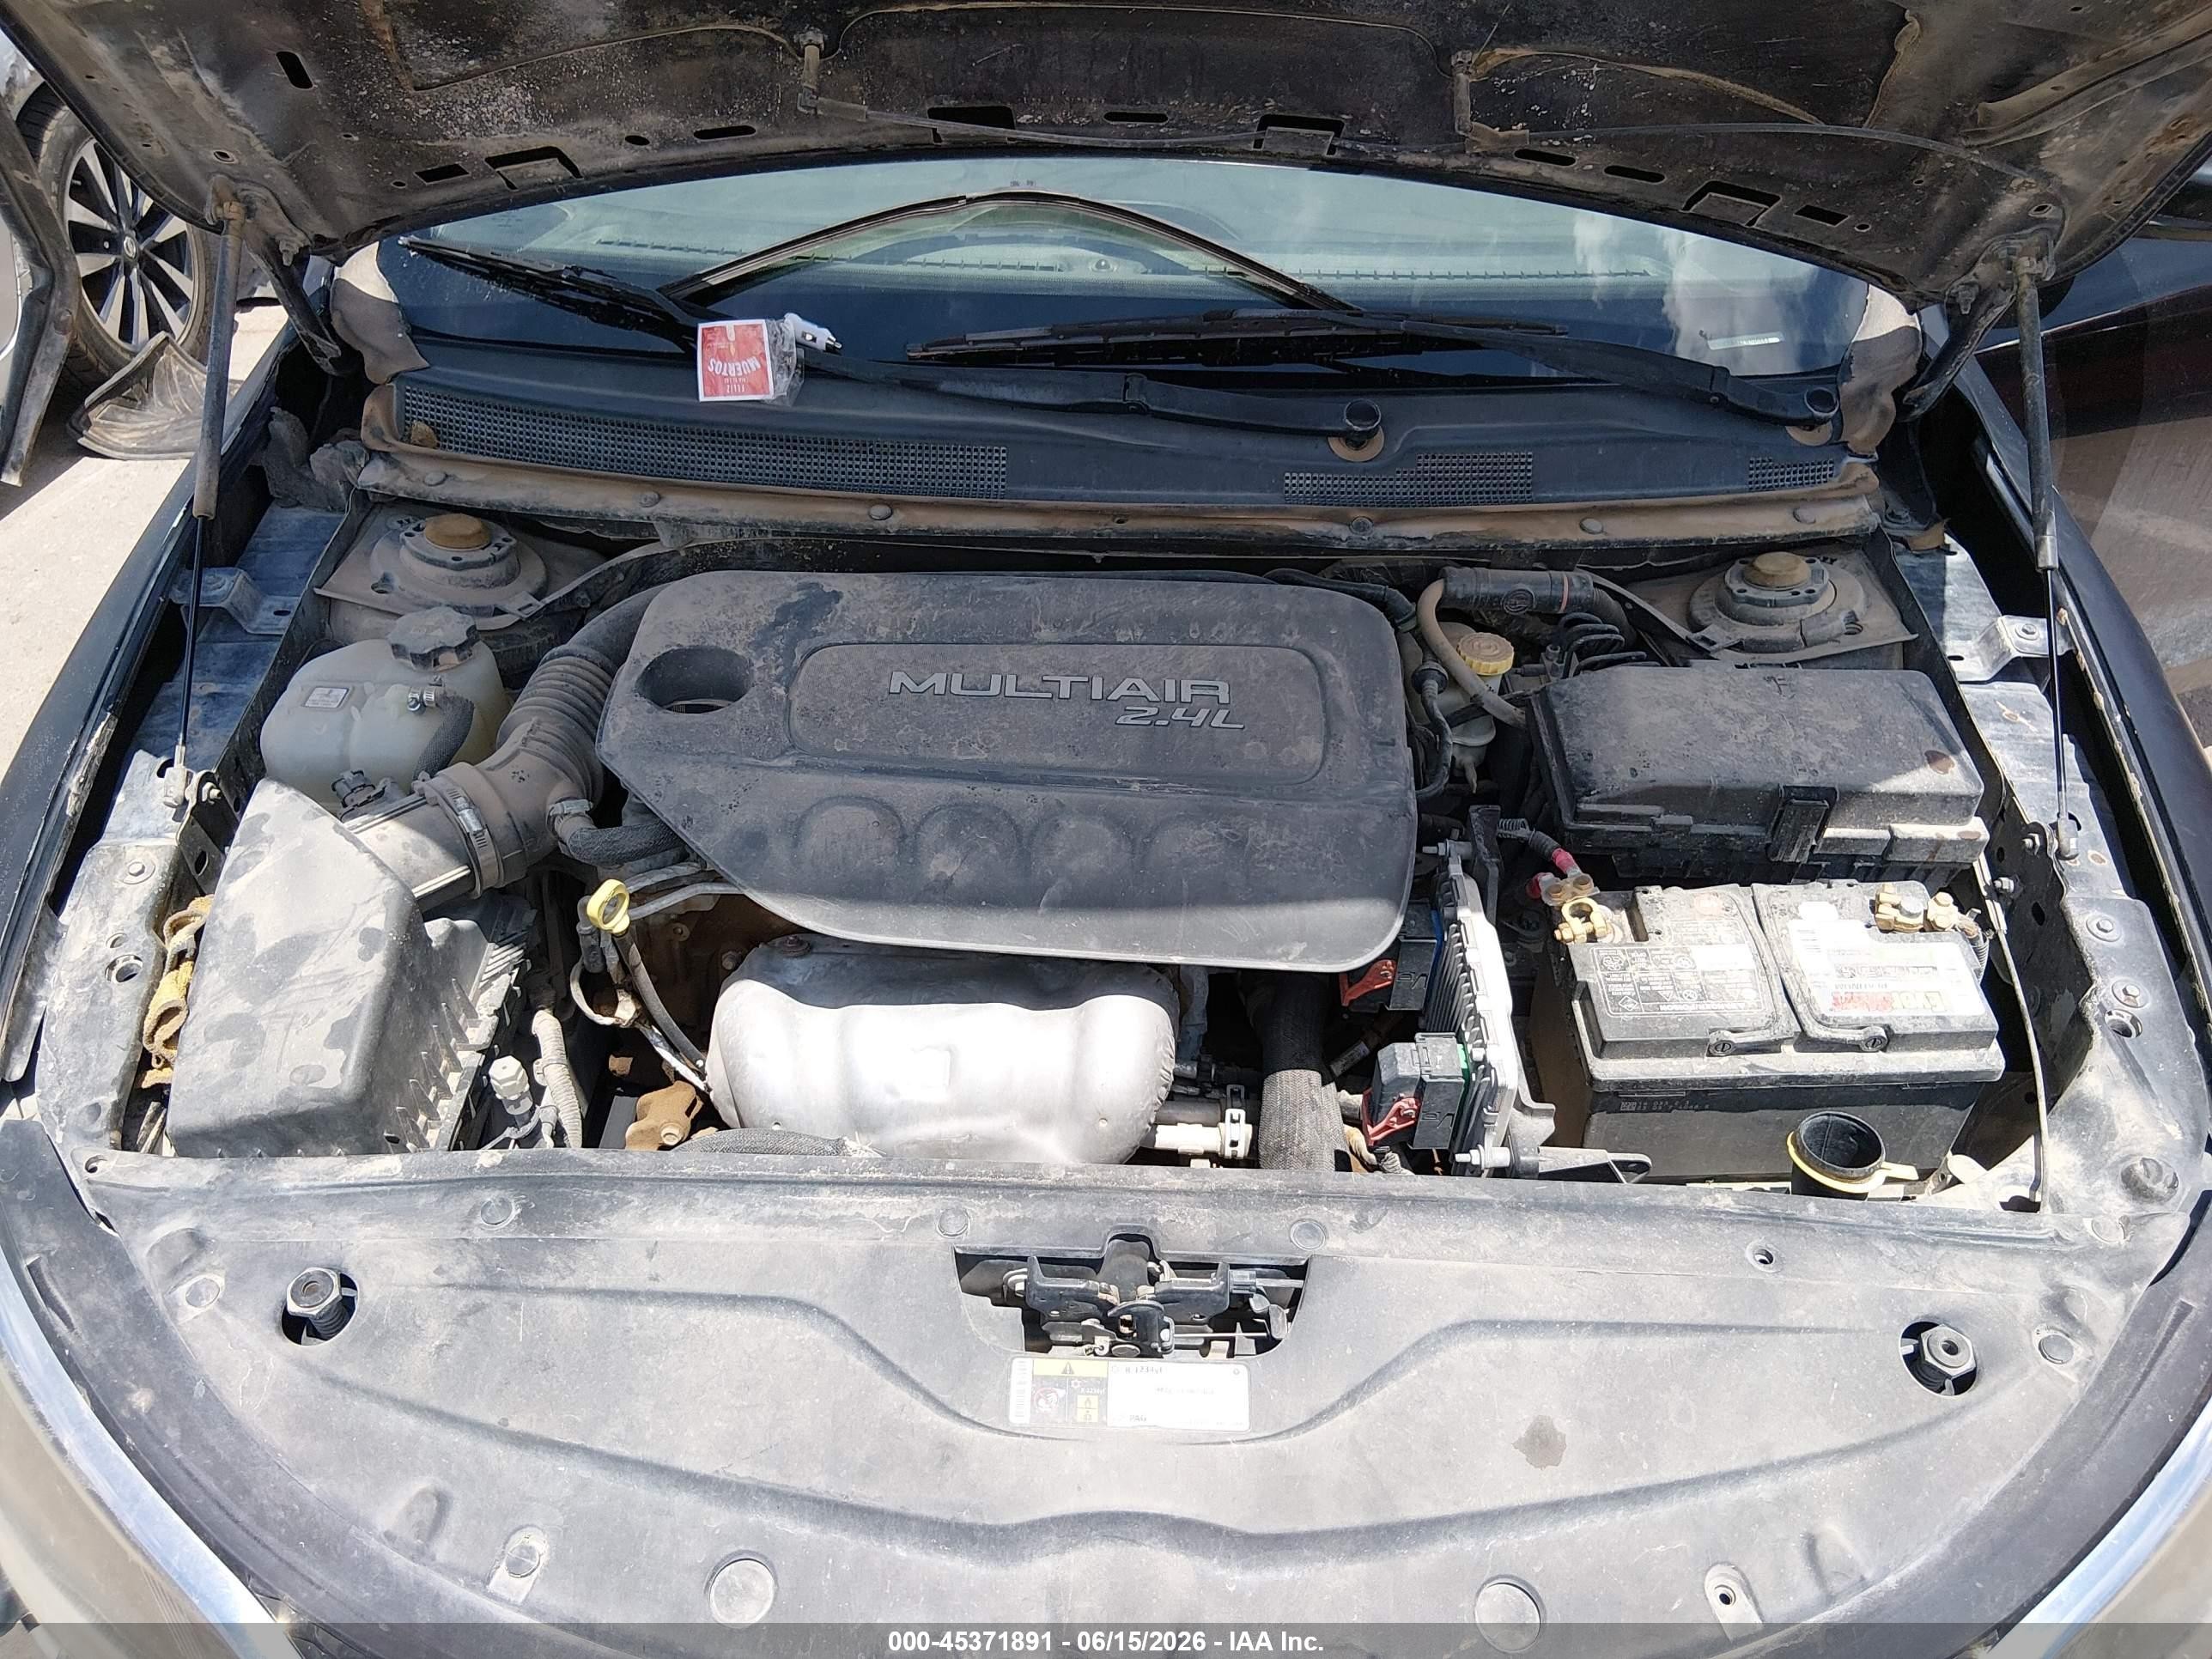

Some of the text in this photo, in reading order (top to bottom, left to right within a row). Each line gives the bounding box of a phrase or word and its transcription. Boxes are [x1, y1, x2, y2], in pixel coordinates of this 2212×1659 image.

[708, 356, 761, 377] MUERTOS
[888, 671, 1231, 704] MULTIAIR
[1115, 705, 1245, 729] 2.4L
